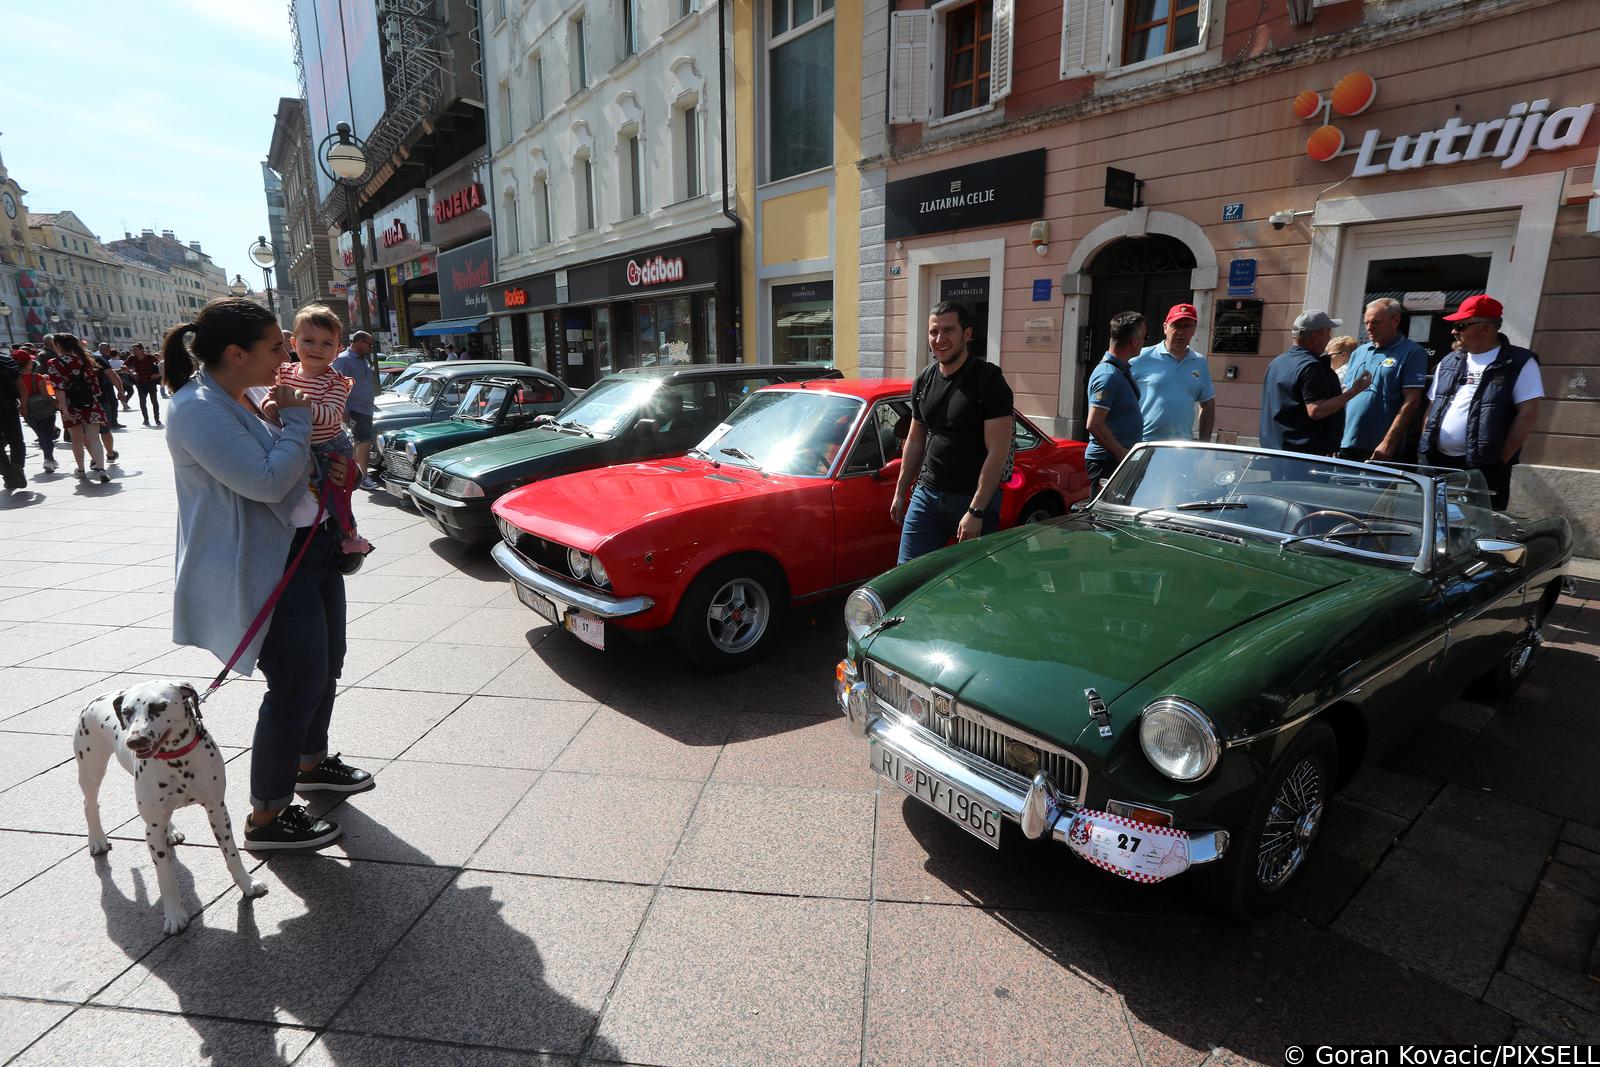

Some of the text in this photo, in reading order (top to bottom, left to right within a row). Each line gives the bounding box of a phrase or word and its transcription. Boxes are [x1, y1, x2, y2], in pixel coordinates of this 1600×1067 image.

[1352, 98, 1595, 177] Lutrija
[434, 183, 482, 224] RIJEKA
[919, 189, 995, 214] ZLATARNA CELJE
[1225, 204, 1240, 216] 27
[641, 256, 684, 285] ciciban
[504, 288, 527, 307] Rodea
[882, 748, 900, 781] RI
[1117, 833, 1142, 853] 27
